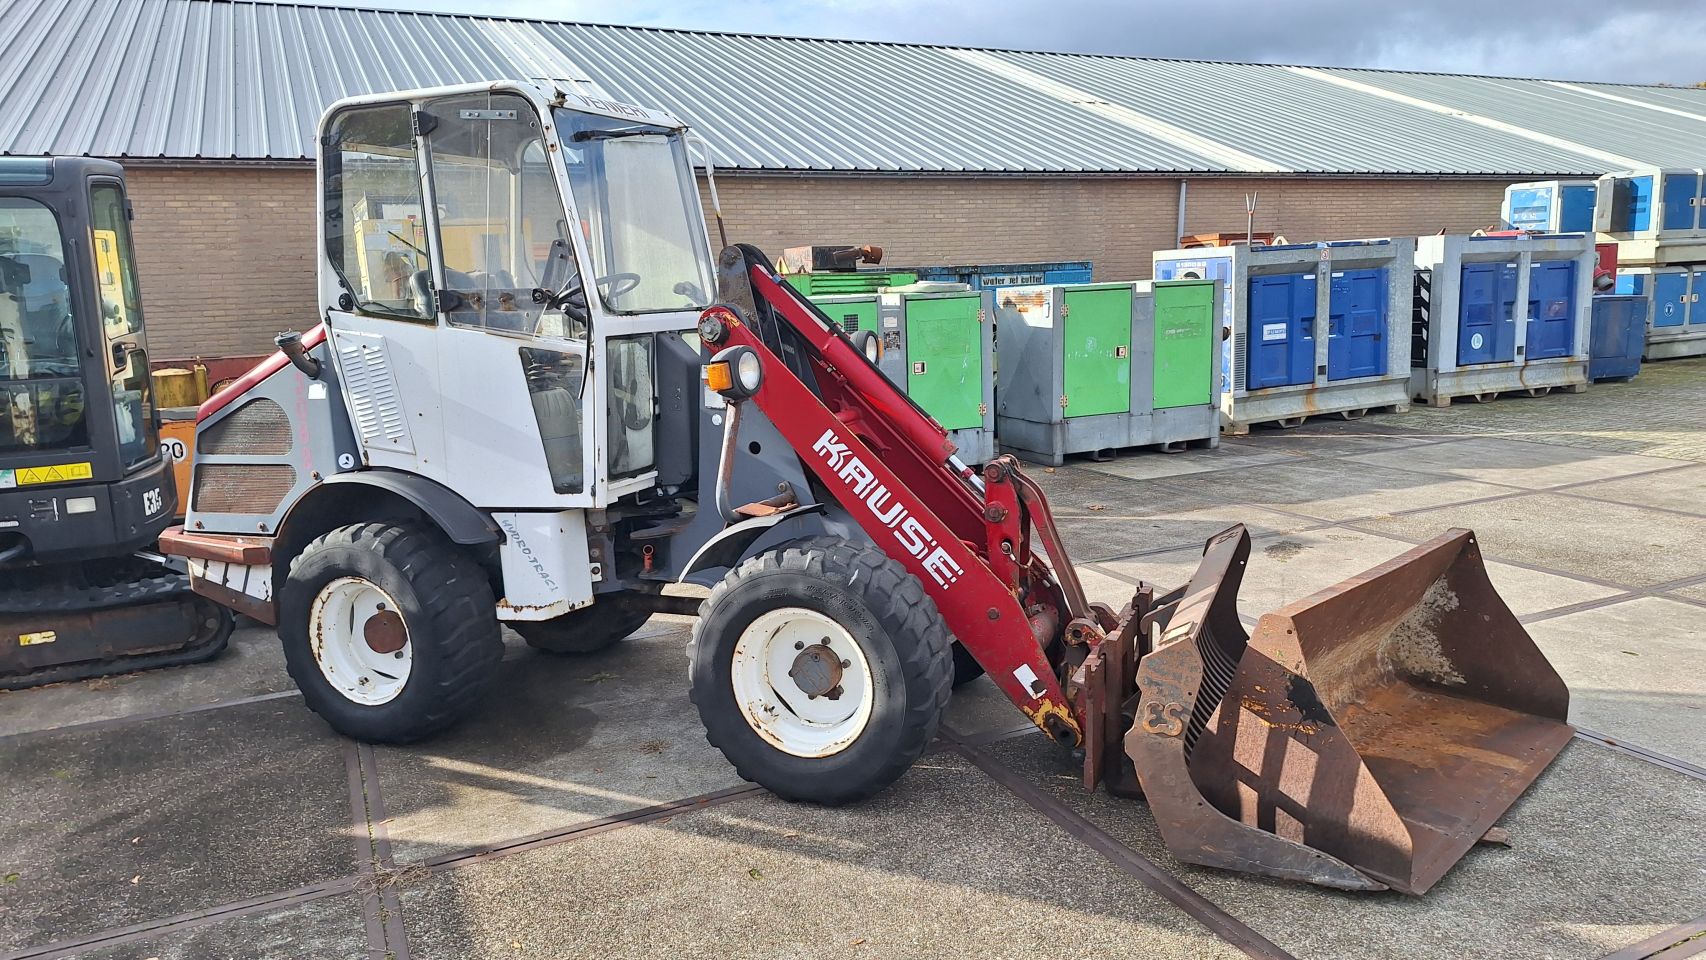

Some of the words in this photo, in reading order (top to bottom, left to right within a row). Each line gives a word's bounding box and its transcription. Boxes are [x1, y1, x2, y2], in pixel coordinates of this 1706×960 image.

[983, 276, 1006, 286] water
[1009, 276, 1019, 285] jet
[1021, 275, 1043, 284] cutter
[143, 488, 162, 516] E35
[812, 428, 965, 590] KRUSE
